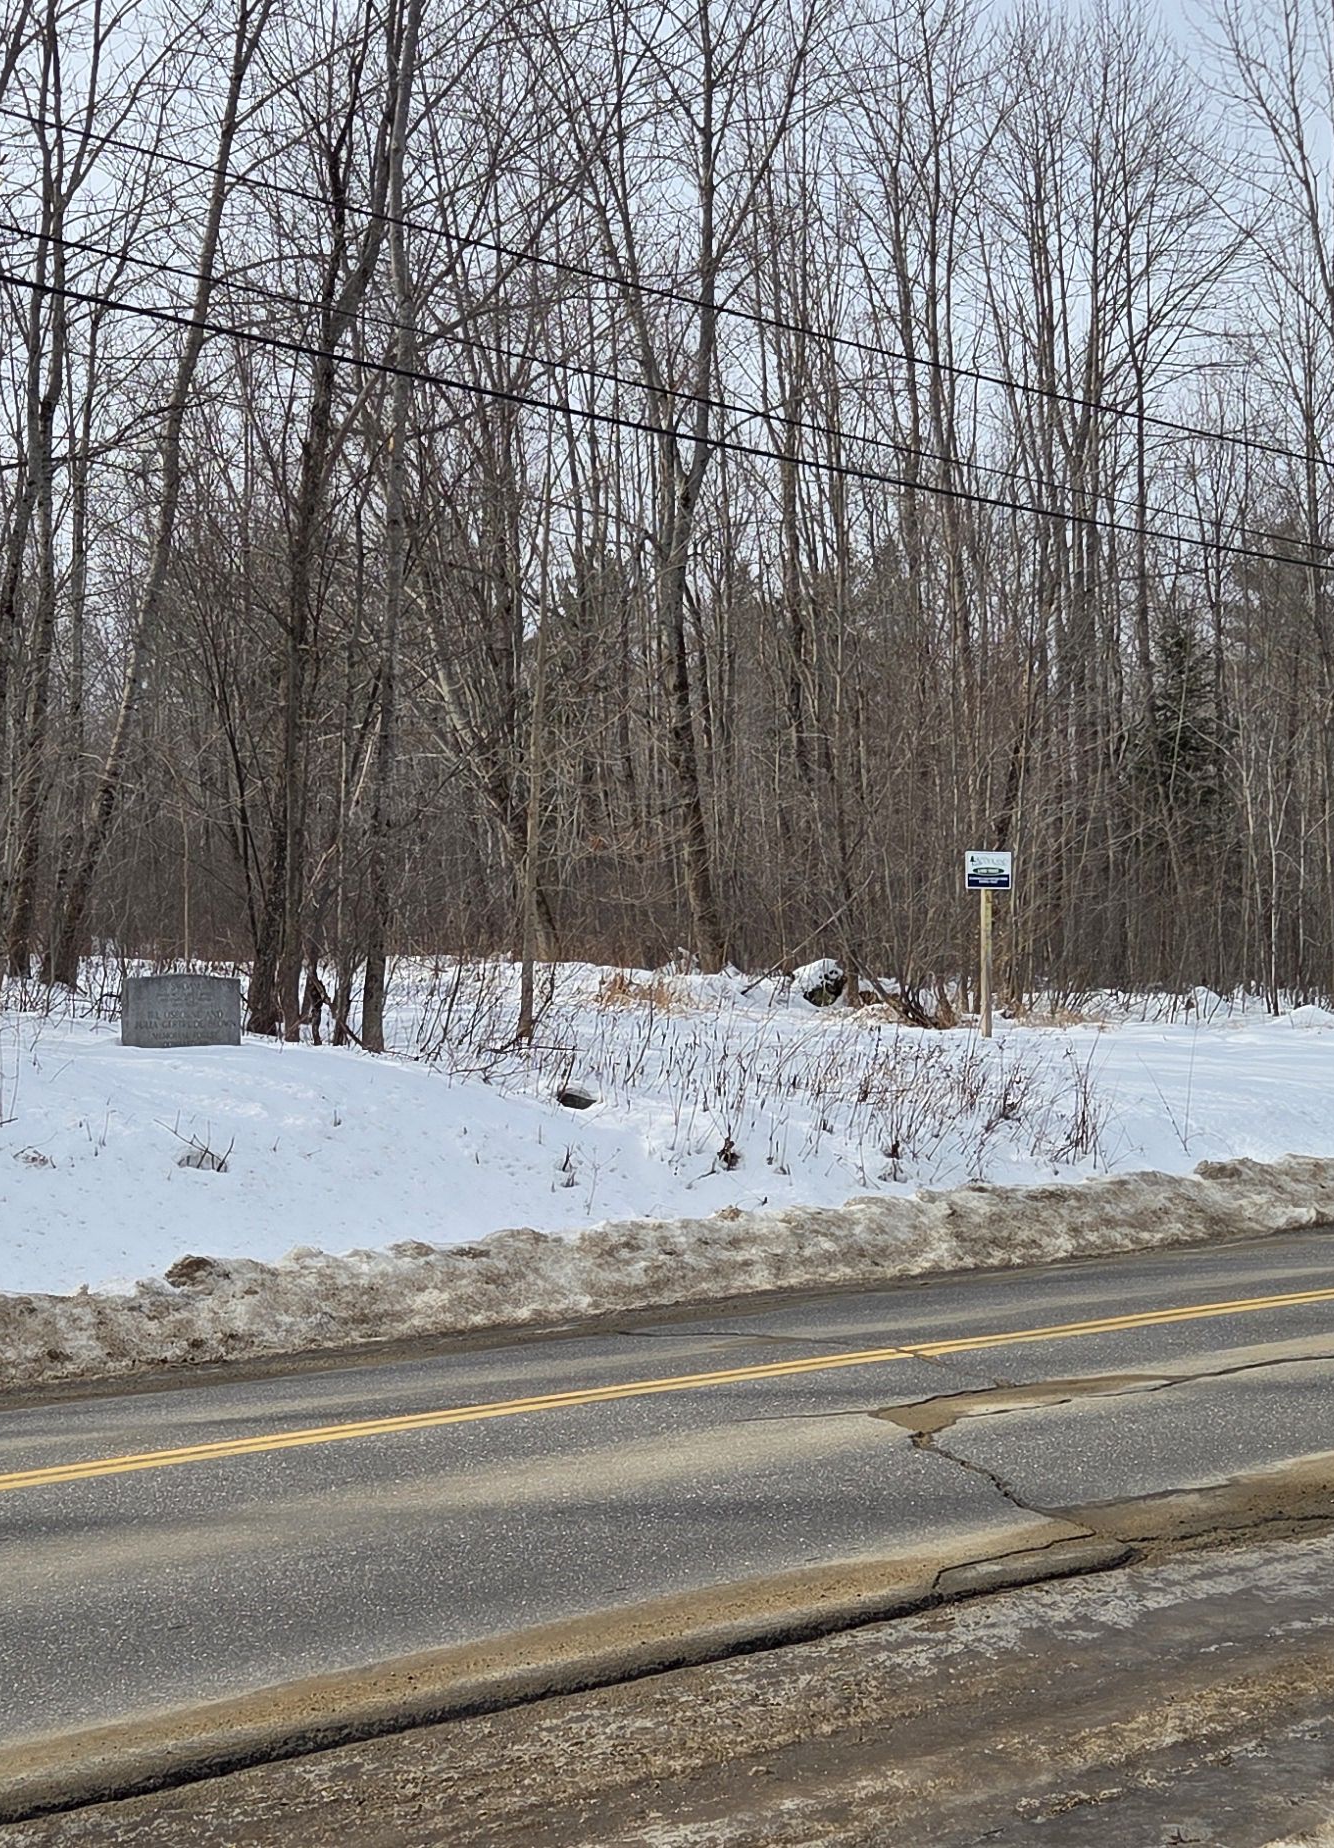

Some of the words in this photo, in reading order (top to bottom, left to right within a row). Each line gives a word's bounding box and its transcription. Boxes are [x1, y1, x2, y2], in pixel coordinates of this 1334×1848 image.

[206, 1009, 223, 1020] AND
[134, 1020, 158, 1029] JULIA
[162, 1020, 204, 1029] GERTRUDE
